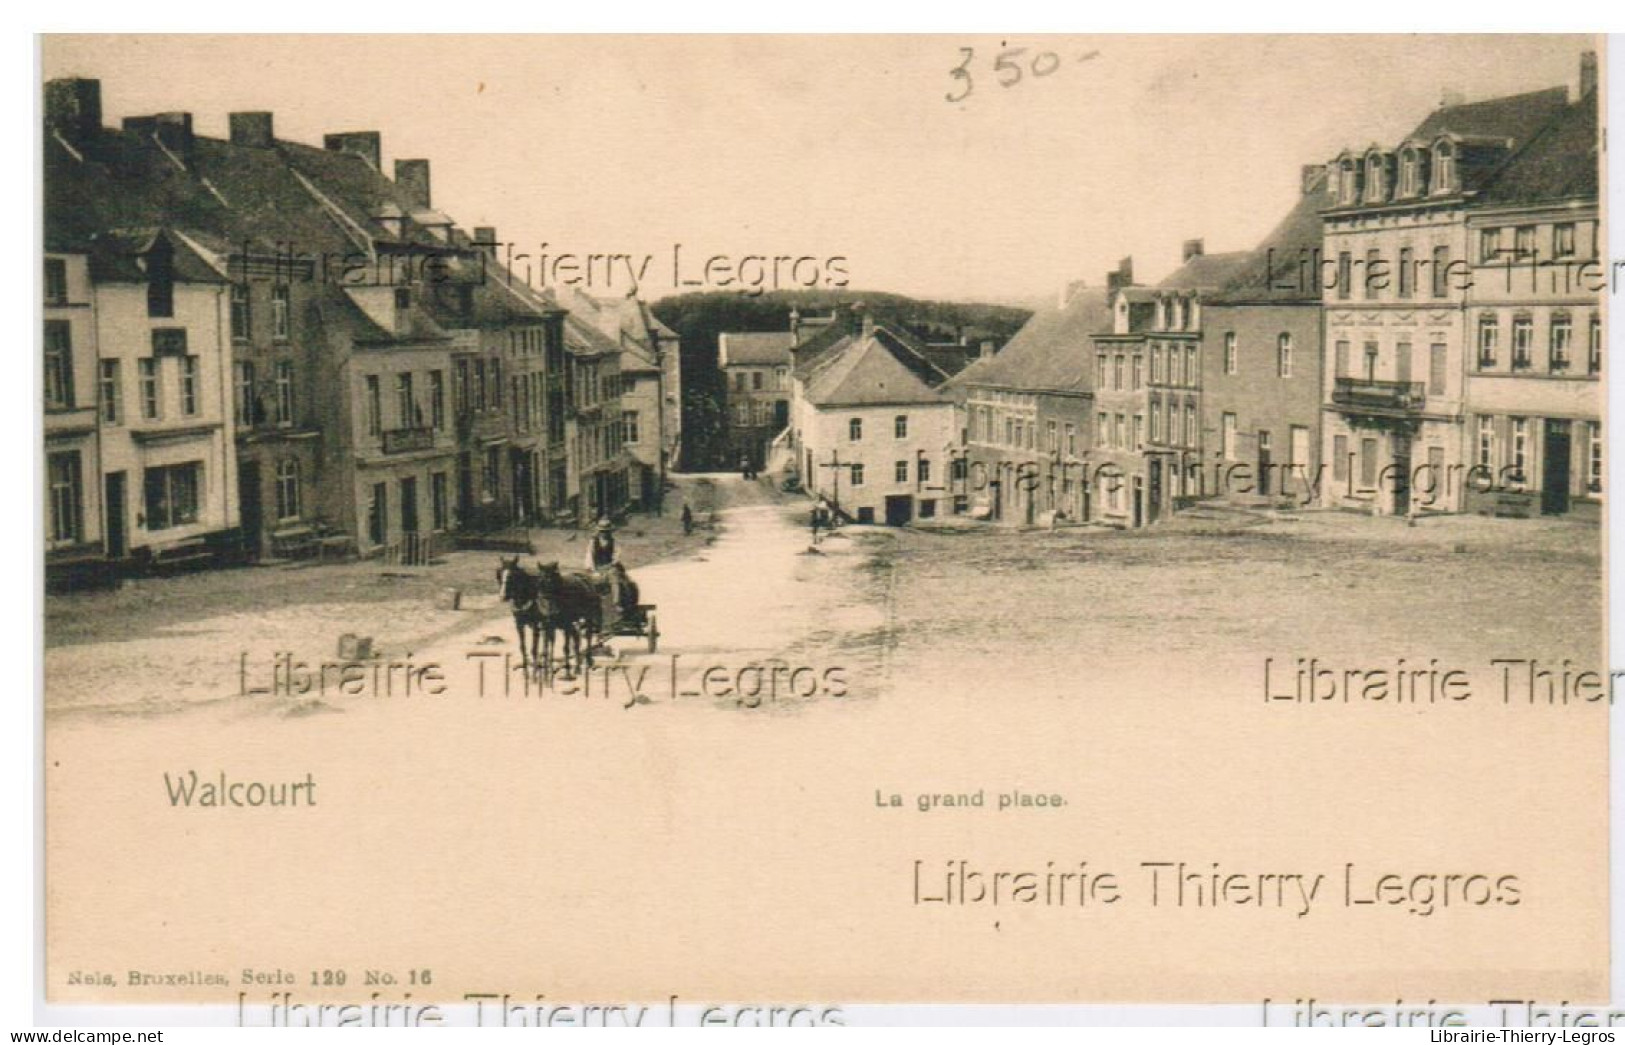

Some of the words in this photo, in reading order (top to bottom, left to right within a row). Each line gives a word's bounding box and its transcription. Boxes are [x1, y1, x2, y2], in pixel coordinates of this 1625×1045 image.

[163, 769, 317, 807] Walcourt
[874, 788, 904, 808] La
[917, 788, 985, 812] grand
[998, 788, 1069, 812] place.
[127, 970, 230, 987] Bruxelles,
[240, 968, 296, 986] Serie
[310, 970, 347, 986] 129
[363, 970, 398, 986] No.
[408, 969, 433, 986] 16
